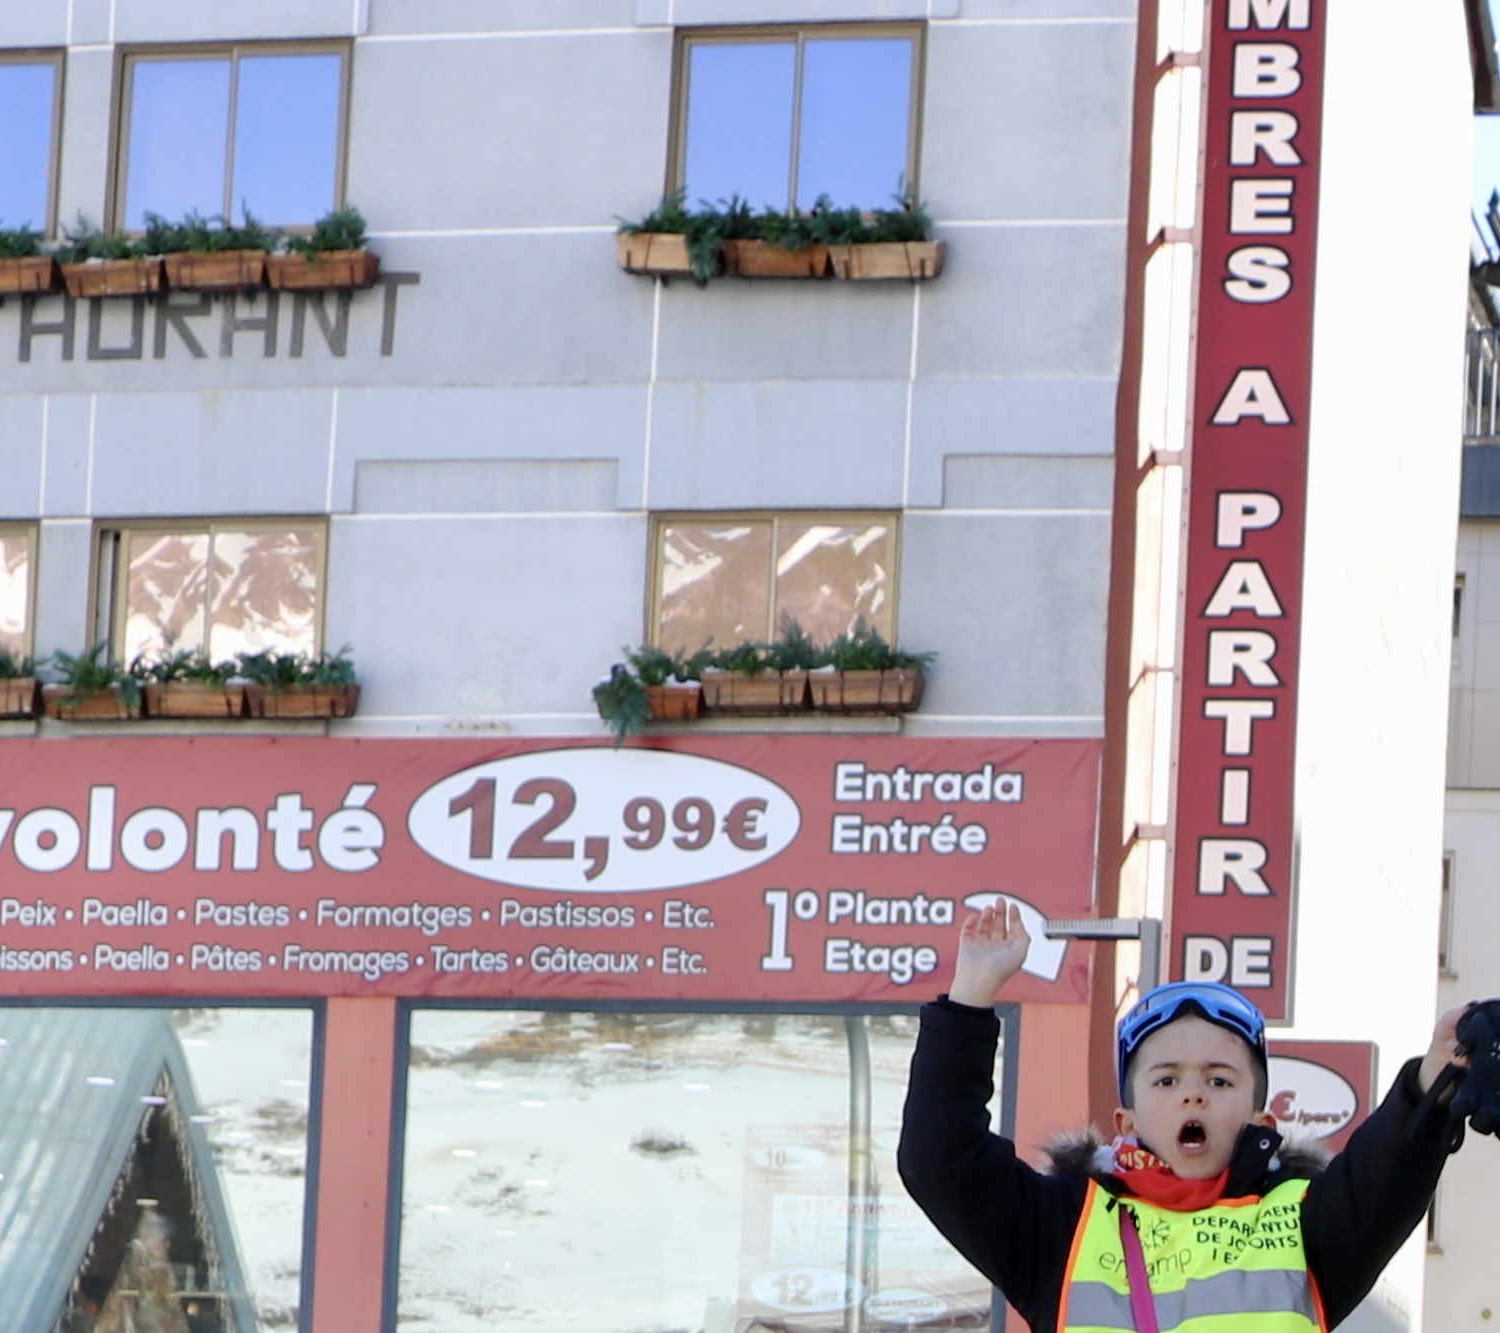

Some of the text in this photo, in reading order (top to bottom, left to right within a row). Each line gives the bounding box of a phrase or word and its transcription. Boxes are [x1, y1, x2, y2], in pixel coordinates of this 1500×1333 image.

[1209, 367, 1293, 427] A
[1196, 490, 1285, 896] PARTIR
[834, 762, 1023, 802] Entrada
[447, 776, 769, 881] 12,99€
[830, 814, 989, 855] Entrée
[1, 898, 56, 927] Peix
[82, 898, 168, 927] Paella
[195, 898, 289, 927] Pastes
[317, 899, 472, 936] Formatges
[500, 899, 635, 927] Pastissos
[663, 899, 715, 928] Etc.
[827, 889, 954, 926] Planta
[95, 943, 169, 970] Paella
[192, 943, 261, 971] Pâtes
[284, 944, 409, 979] Fromages
[431, 945, 508, 972] Tartes
[530, 946, 639, 972] Gâteaux
[662, 946, 708, 973] Etc.
[823, 939, 938, 983] Etage
[1184, 935, 1274, 987] DE
[1197, 1230, 1221, 1244] DE
[1099, 1248, 1192, 1277] enamp
